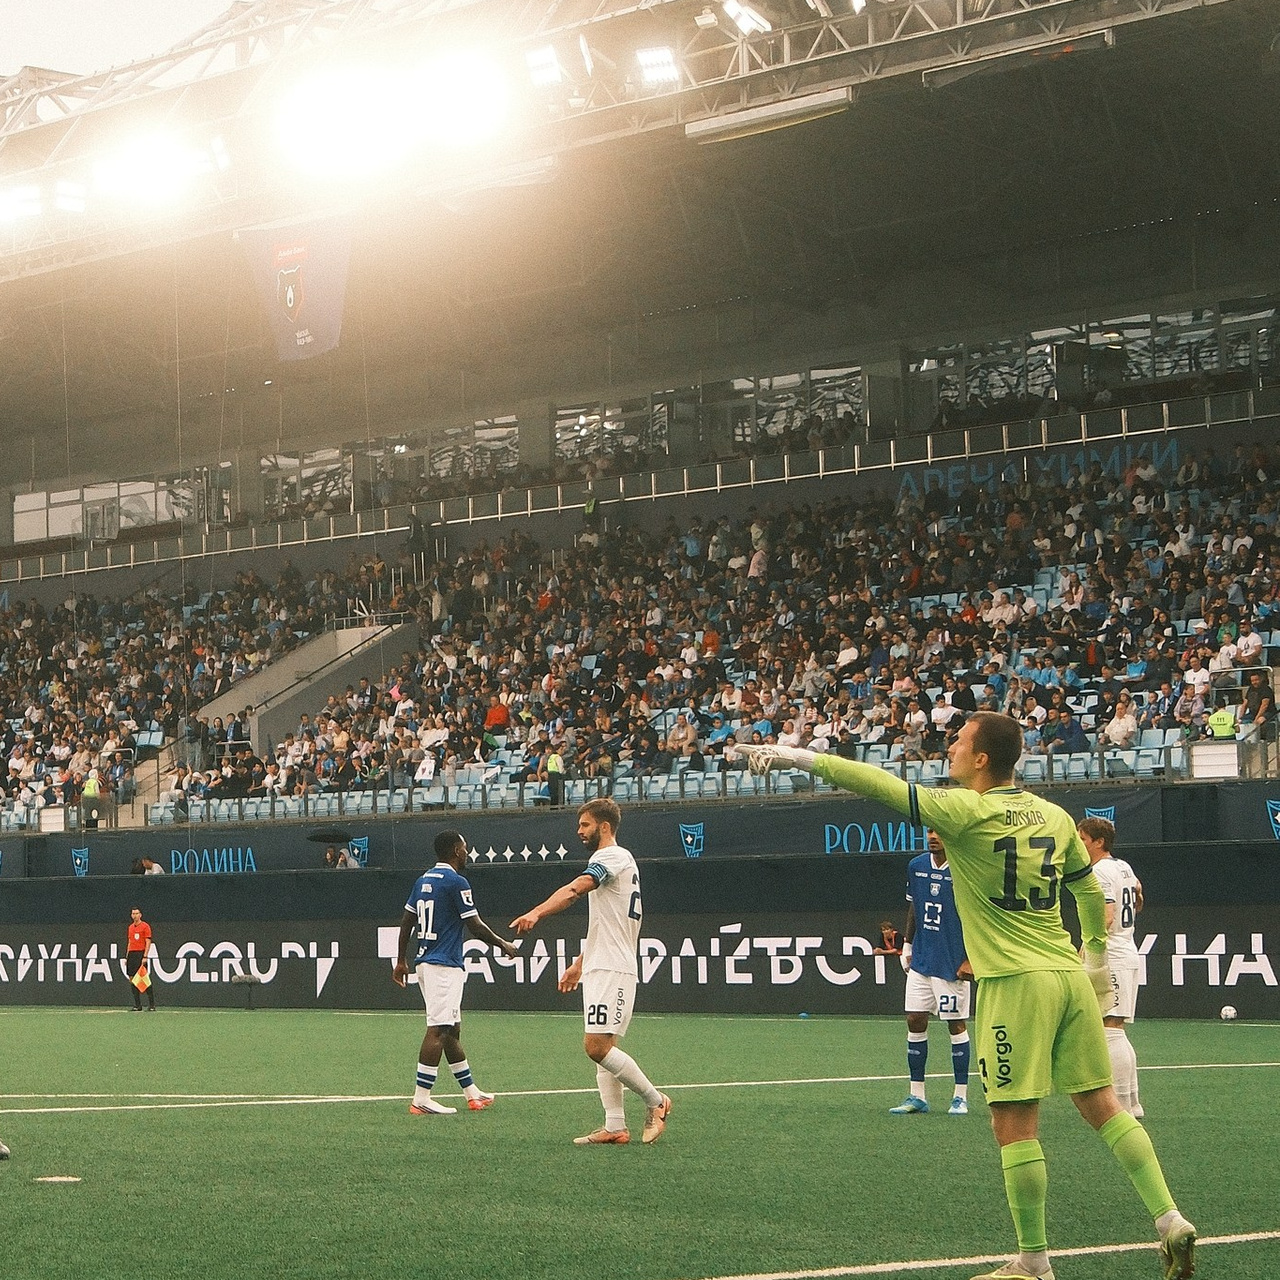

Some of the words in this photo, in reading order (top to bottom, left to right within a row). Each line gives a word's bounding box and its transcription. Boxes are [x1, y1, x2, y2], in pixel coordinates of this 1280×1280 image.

[989, 836, 1057, 912] 13
[417, 899, 438, 941] 91
[587, 1004, 608, 1026] 26
[939, 995, 959, 1014] 21
[991, 1024, 1013, 1089] Vorgol
